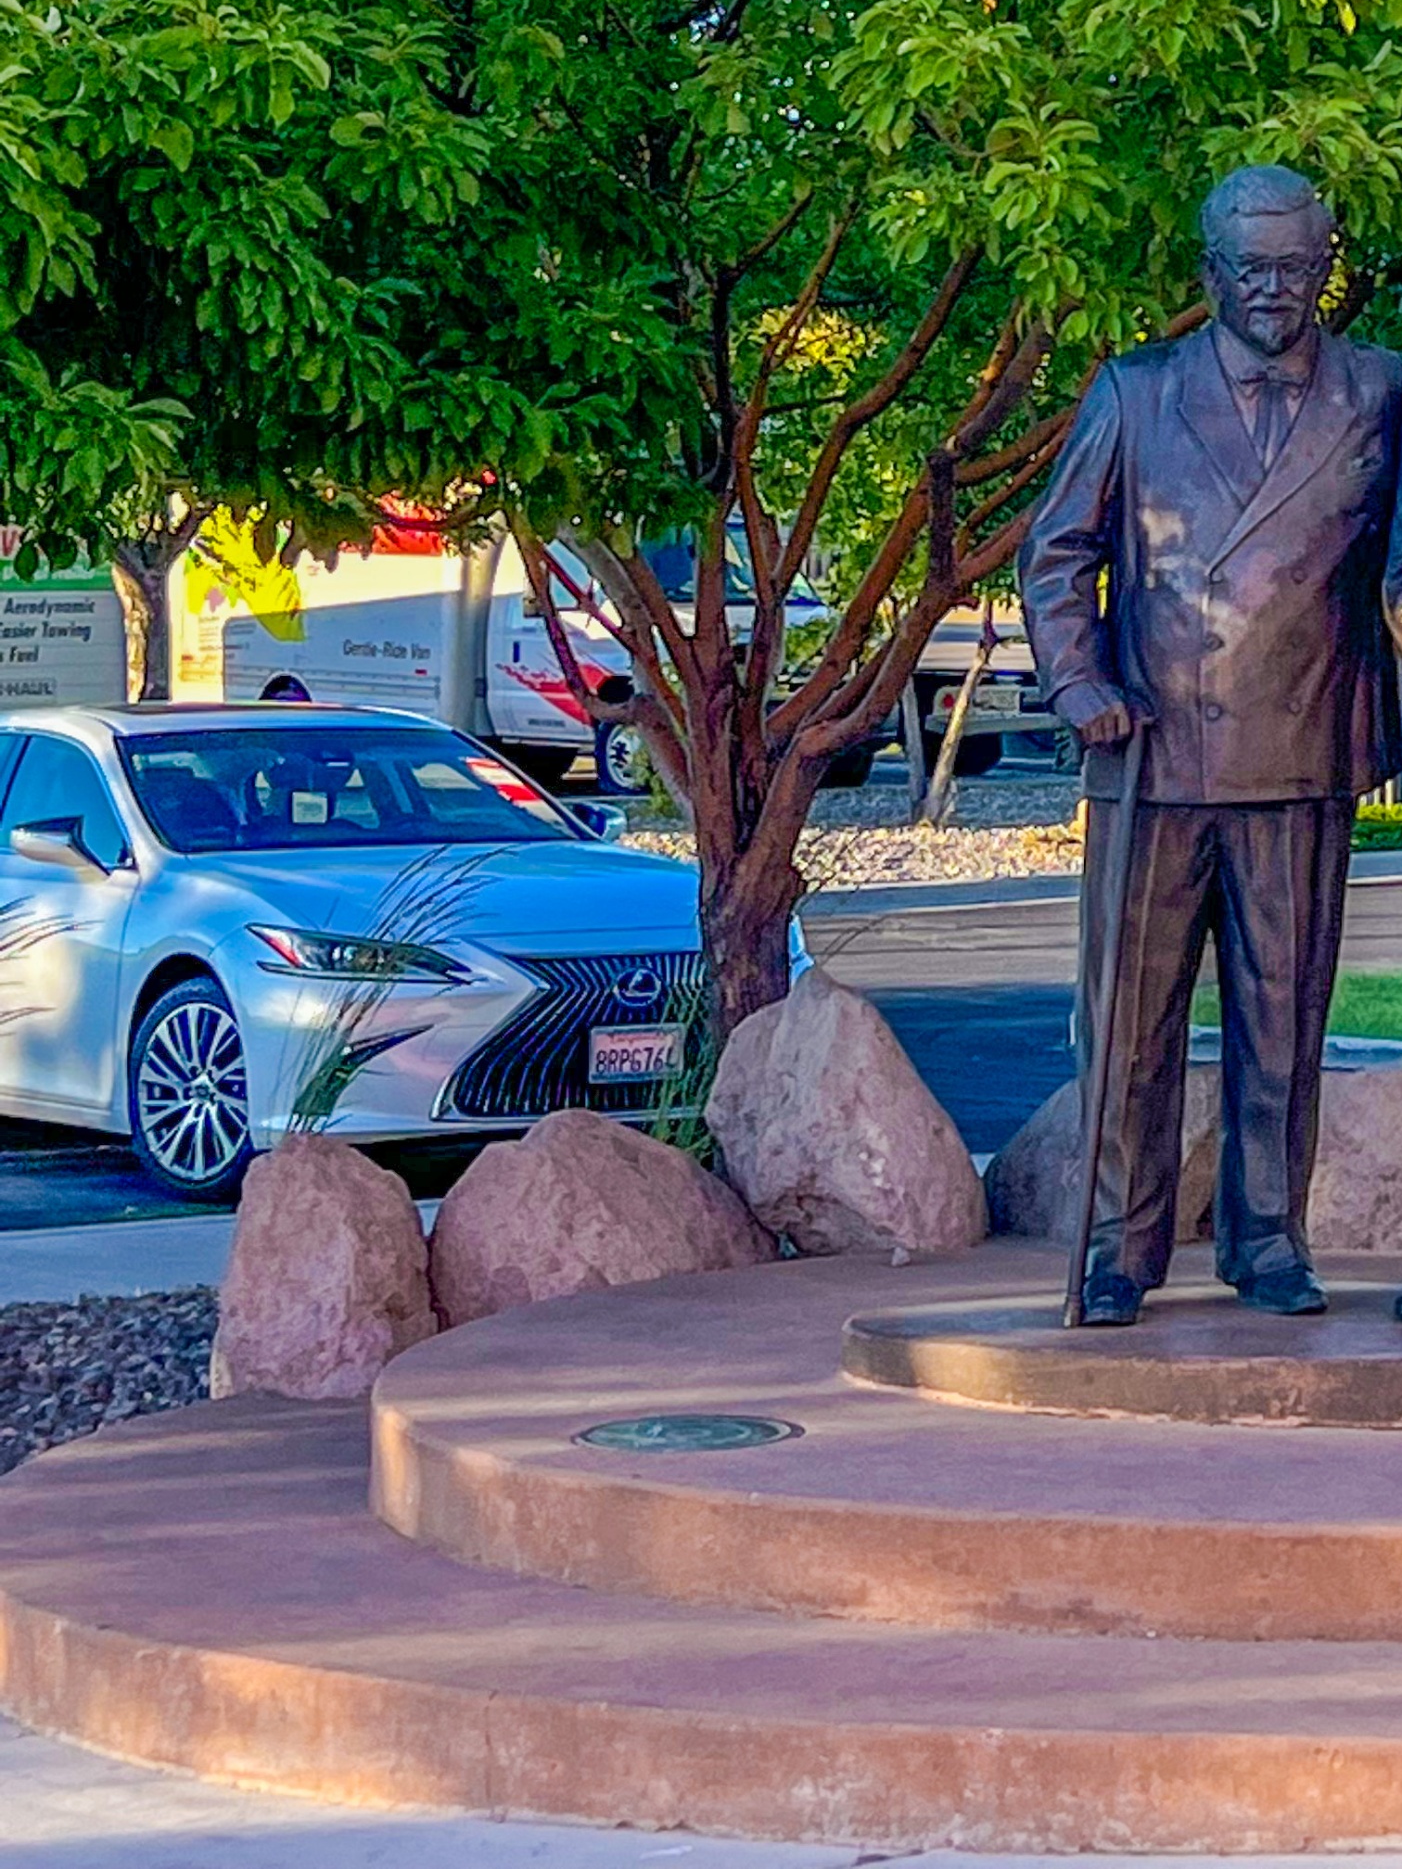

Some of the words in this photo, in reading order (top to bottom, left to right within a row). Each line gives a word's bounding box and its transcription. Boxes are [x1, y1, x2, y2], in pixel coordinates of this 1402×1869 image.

[4, 598, 95, 618] Aerodynamic
[42, 621, 91, 642] Towing
[9, 645, 39, 662] Fuel
